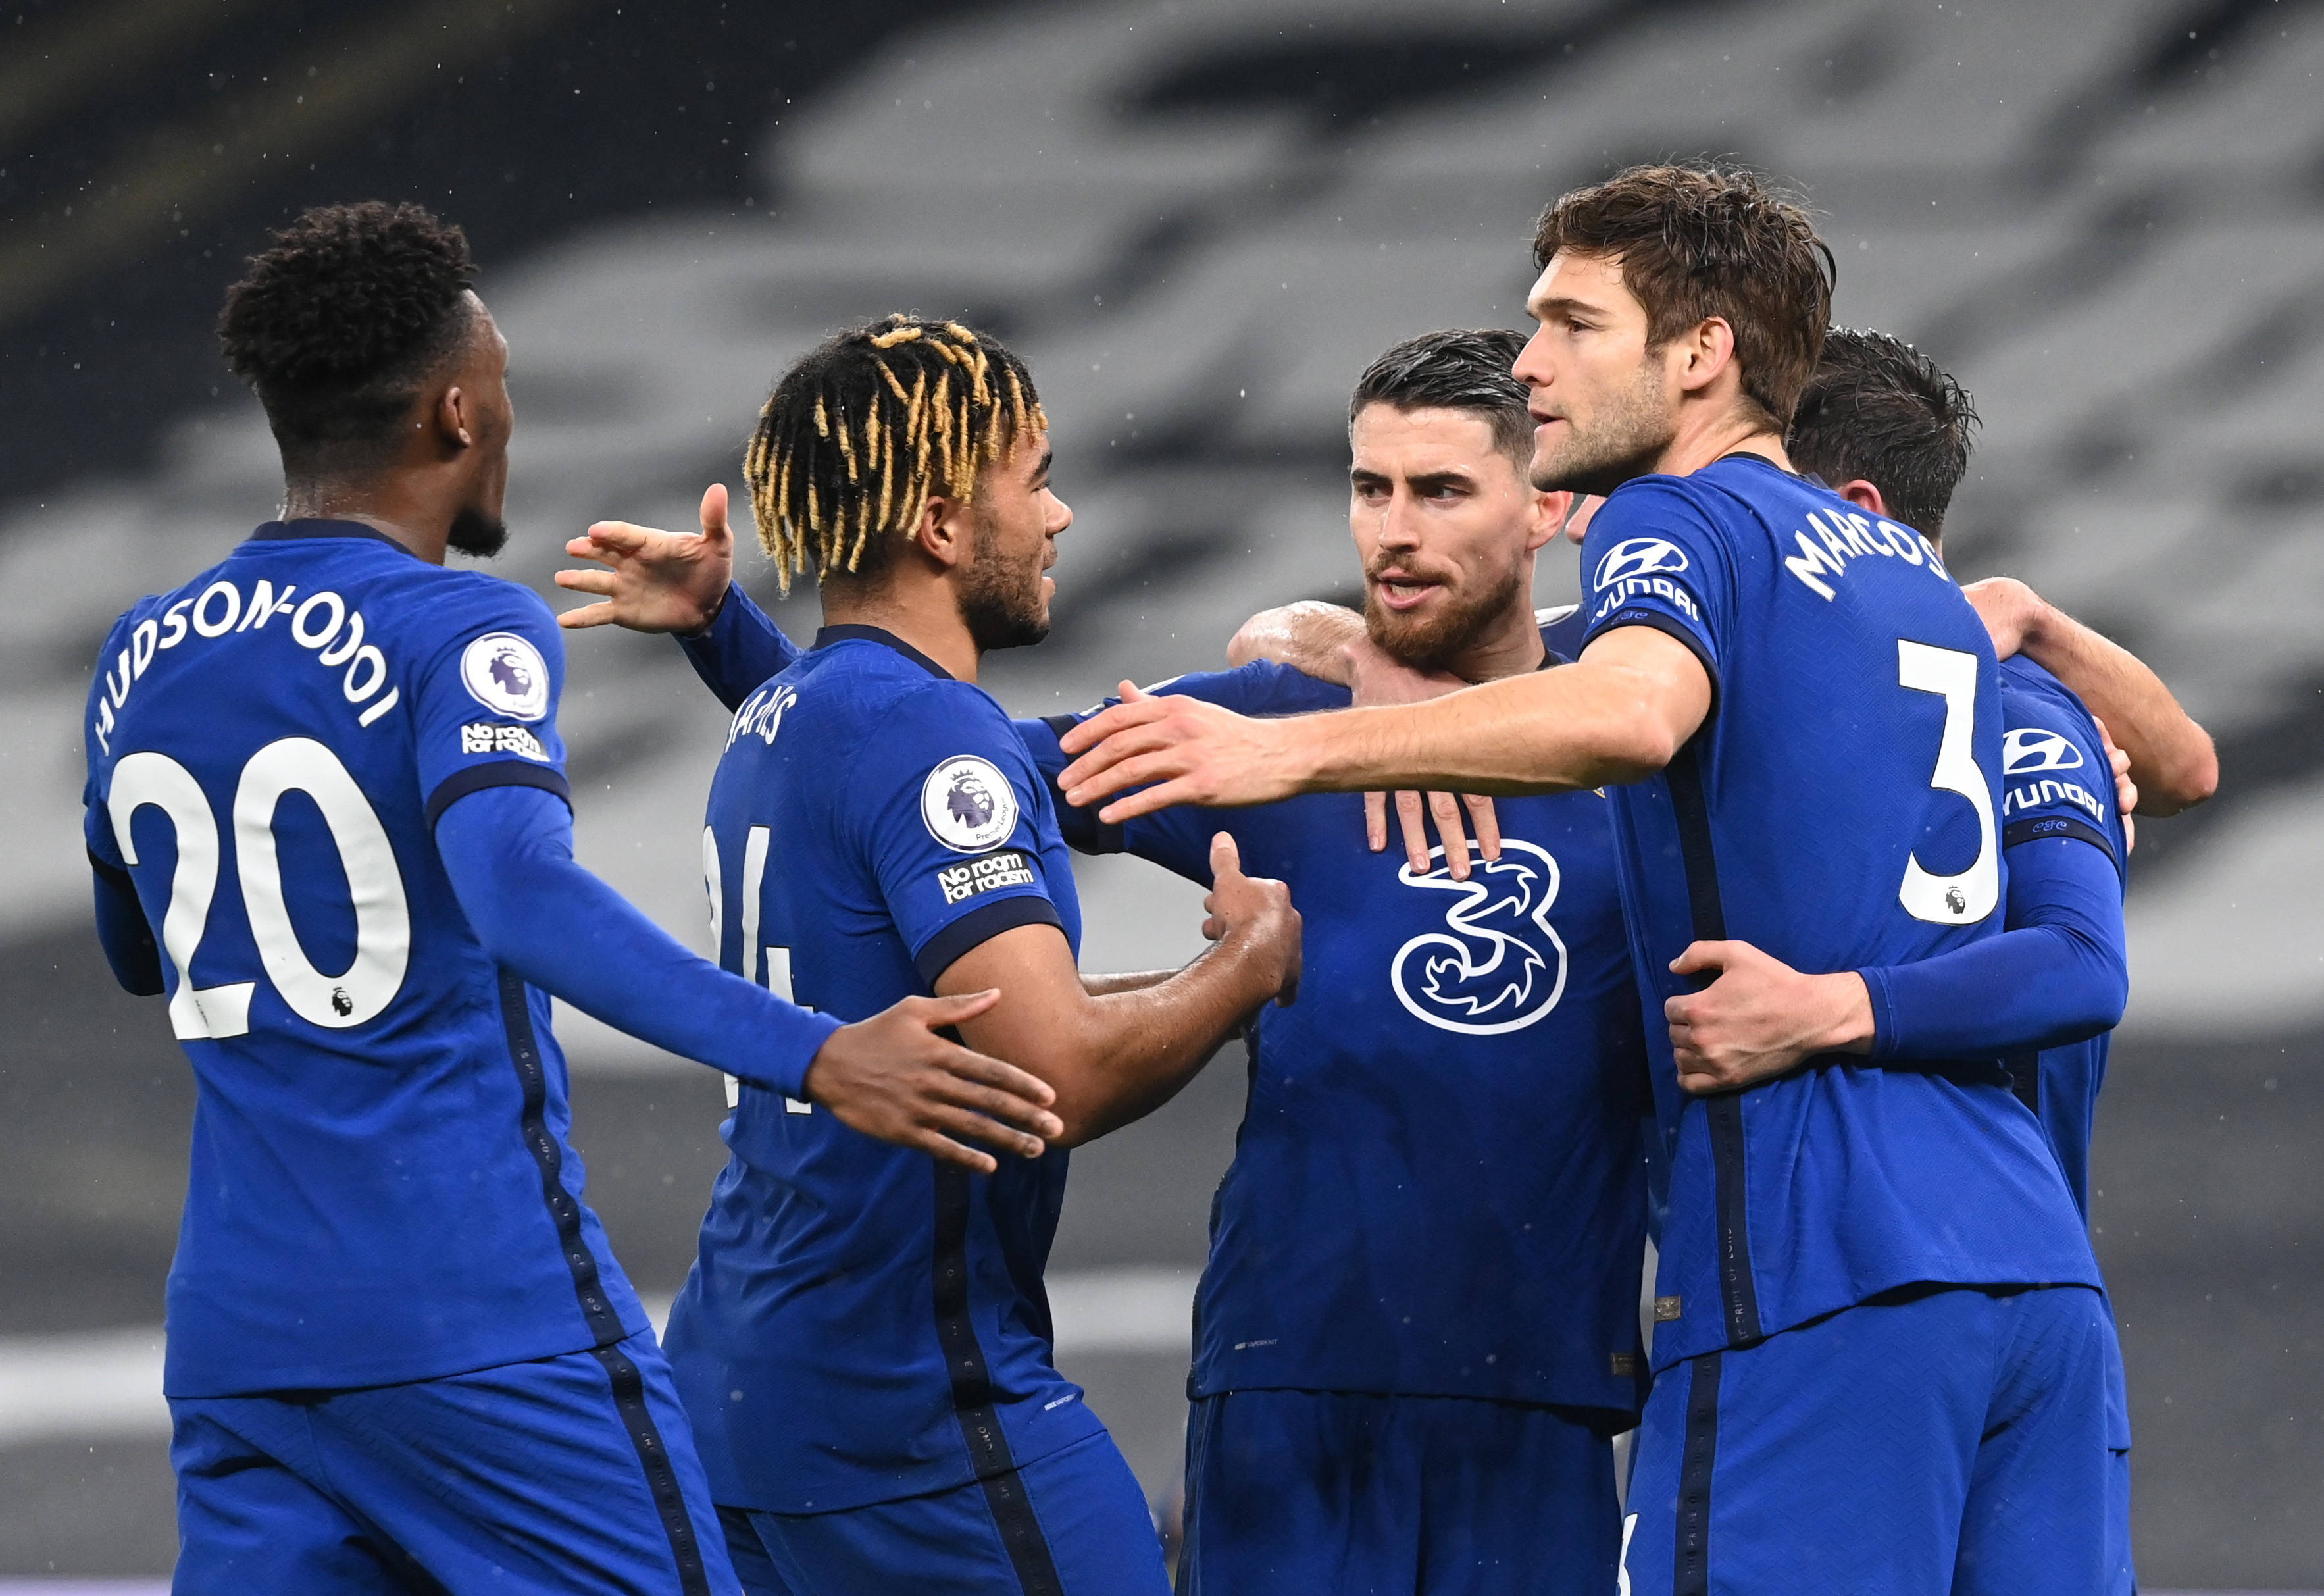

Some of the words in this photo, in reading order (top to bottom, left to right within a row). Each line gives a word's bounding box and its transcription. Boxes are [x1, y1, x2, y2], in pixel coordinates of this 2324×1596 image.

[1784, 508, 1950, 603] MARCOS
[95, 579, 399, 757] HUDSON-ODOI
[461, 723, 494, 740] No
[495, 726, 541, 754] room
[462, 738, 494, 754] for
[1897, 638, 2000, 925] 3
[976, 825, 1000, 841] Premer
[938, 867, 971, 887] No
[971, 854, 1023, 878] room
[944, 881, 974, 904] for
[975, 869, 1034, 892] racism
[107, 736, 411, 1041] 20
